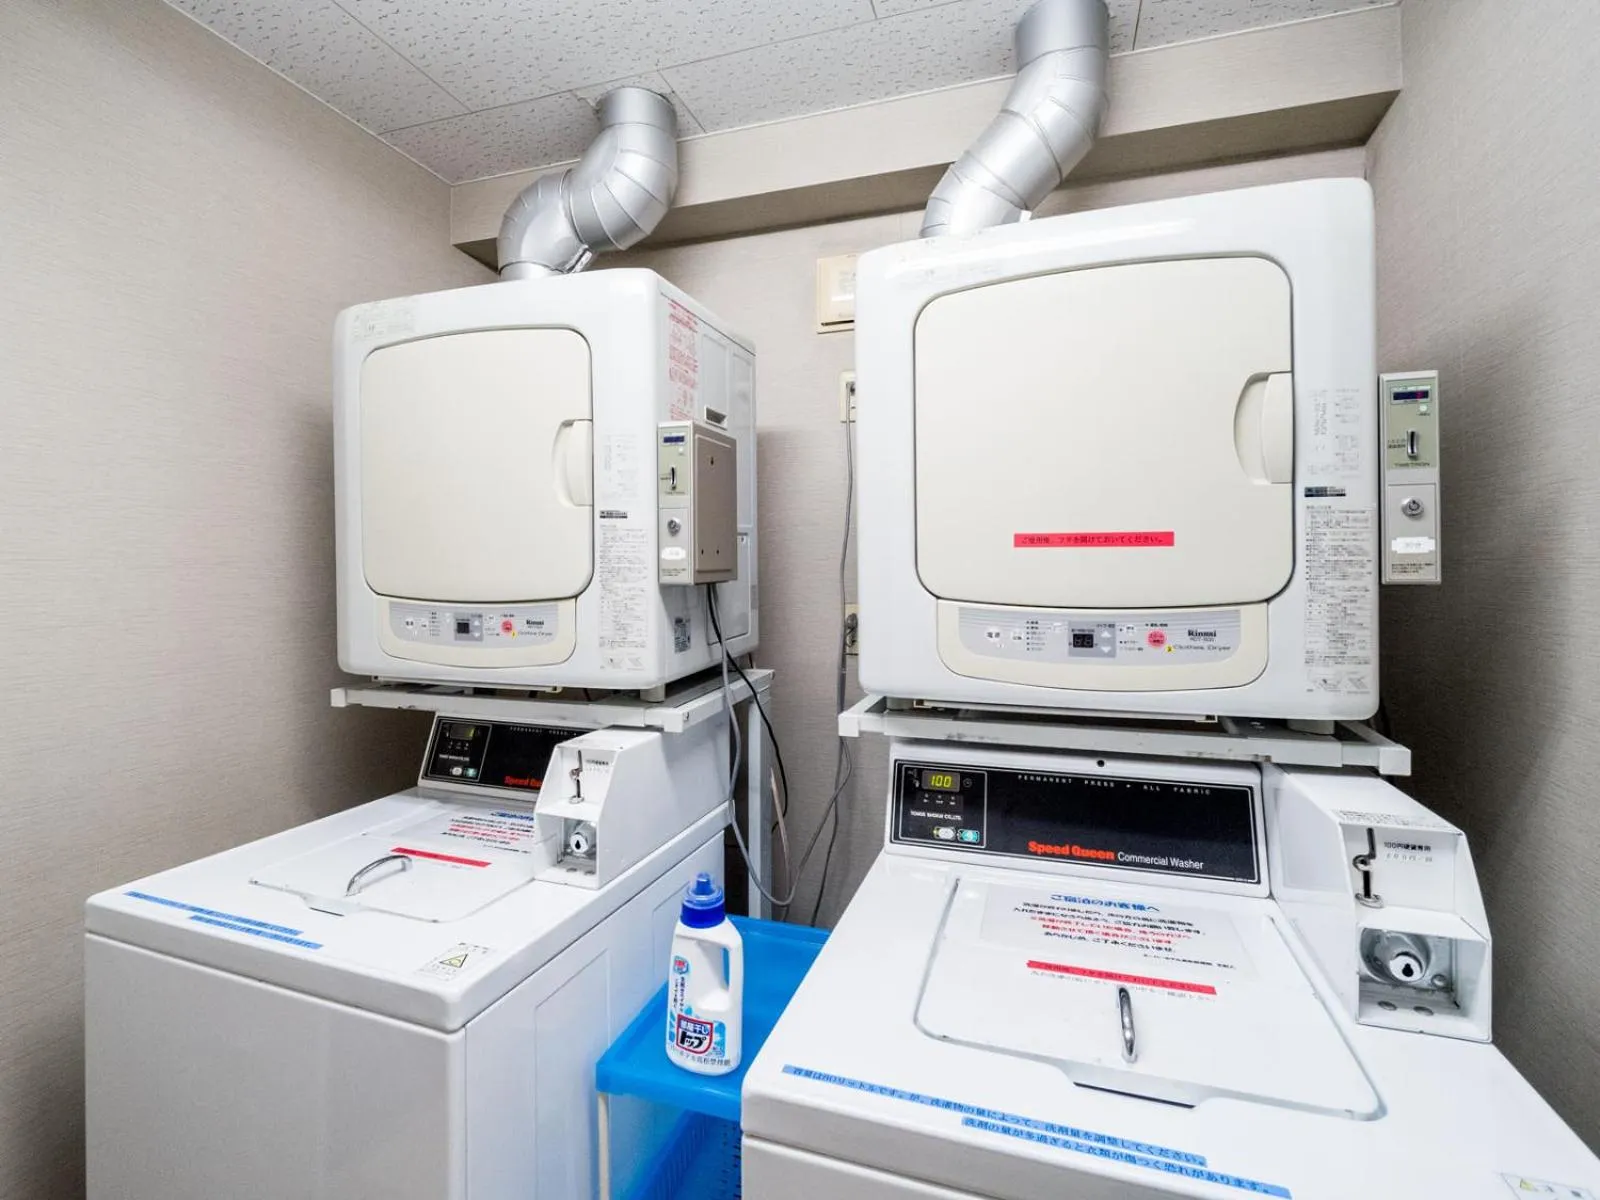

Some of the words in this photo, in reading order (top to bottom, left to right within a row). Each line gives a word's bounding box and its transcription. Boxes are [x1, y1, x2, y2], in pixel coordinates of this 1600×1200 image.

[1188, 629, 1217, 637] Rinnai
[931, 775, 952, 788] 100
[1027, 840, 1070, 856] Speed
[1071, 844, 1115, 861] Queen
[1117, 851, 1169, 867] Commercial
[1170, 857, 1204, 870] Washer
[679, 1030, 707, 1049] トップ
